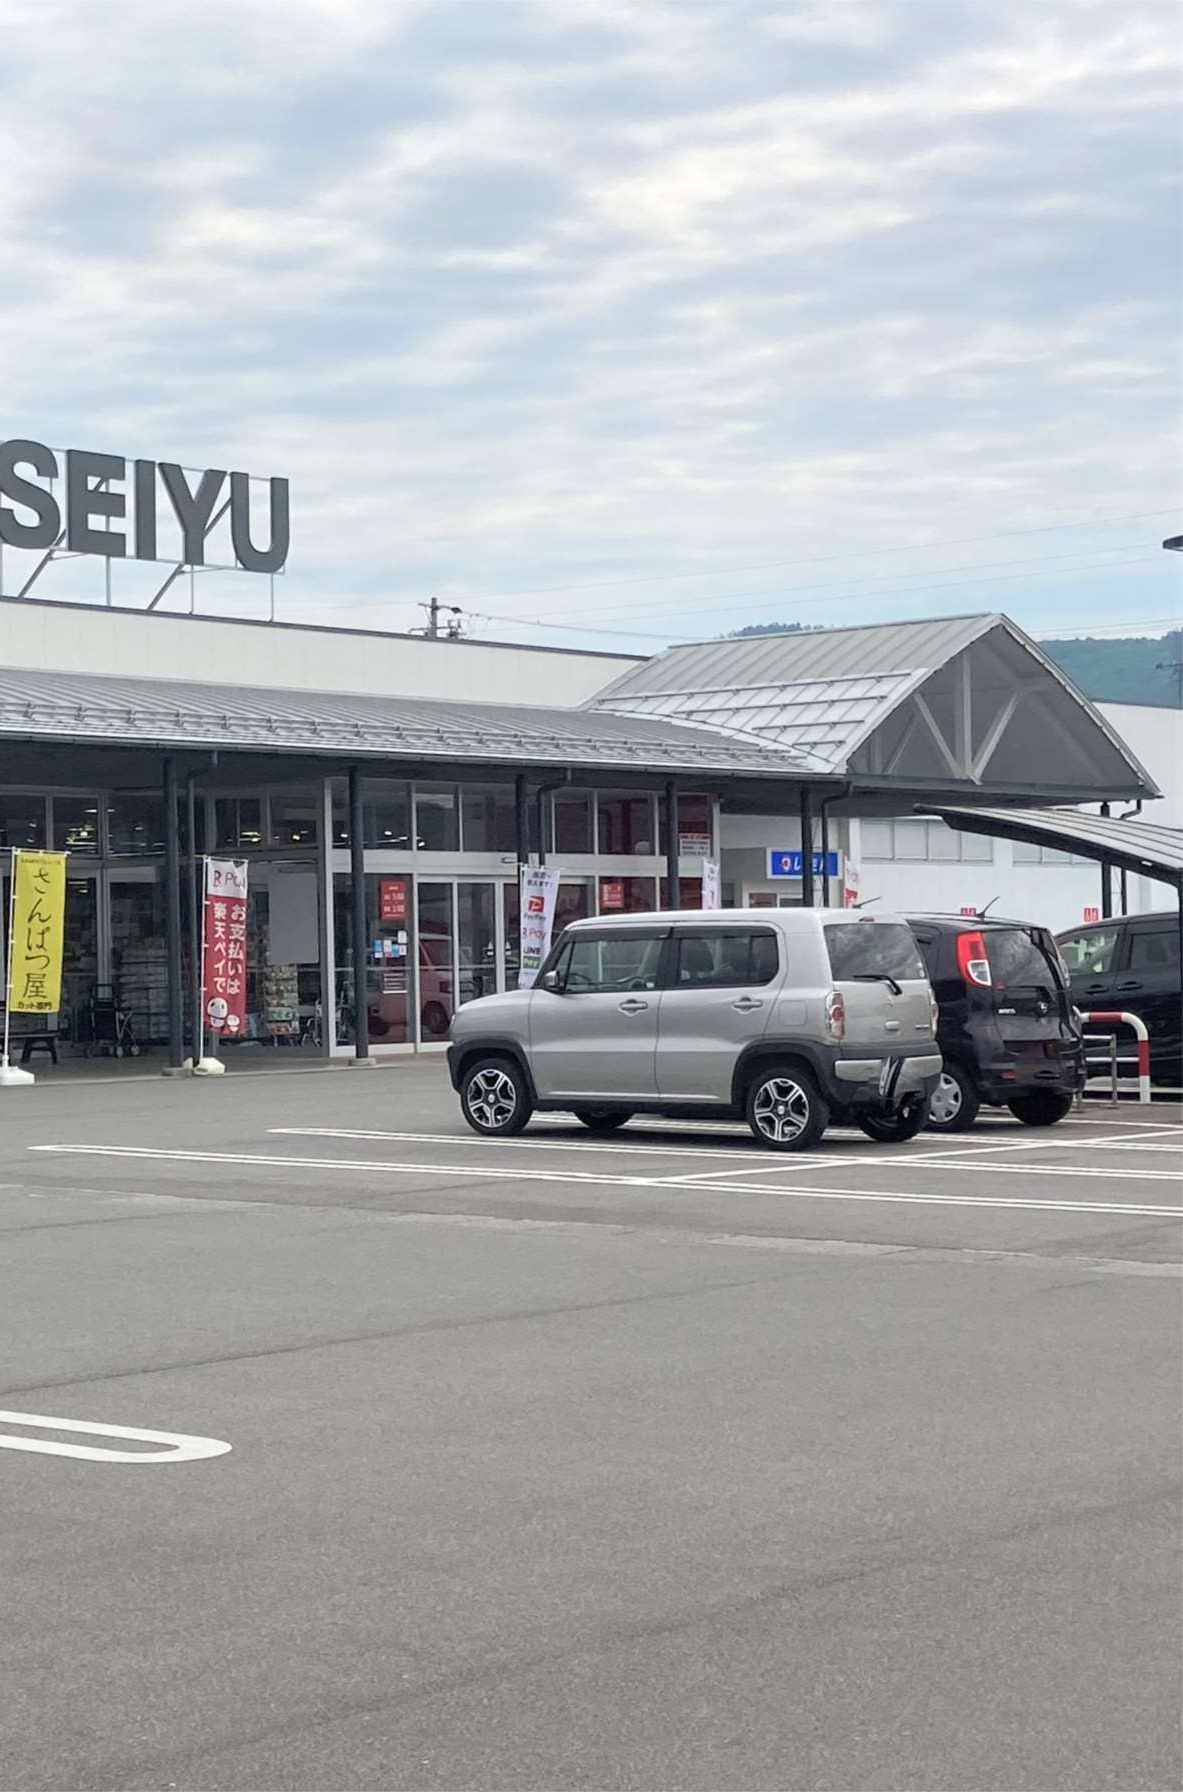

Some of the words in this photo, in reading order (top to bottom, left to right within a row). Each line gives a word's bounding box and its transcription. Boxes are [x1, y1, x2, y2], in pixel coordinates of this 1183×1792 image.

[23, 868, 52, 999] さんぱつ屋
[213, 902, 227, 993] 楽天ペイで
[227, 904, 246, 995] お支払いは
